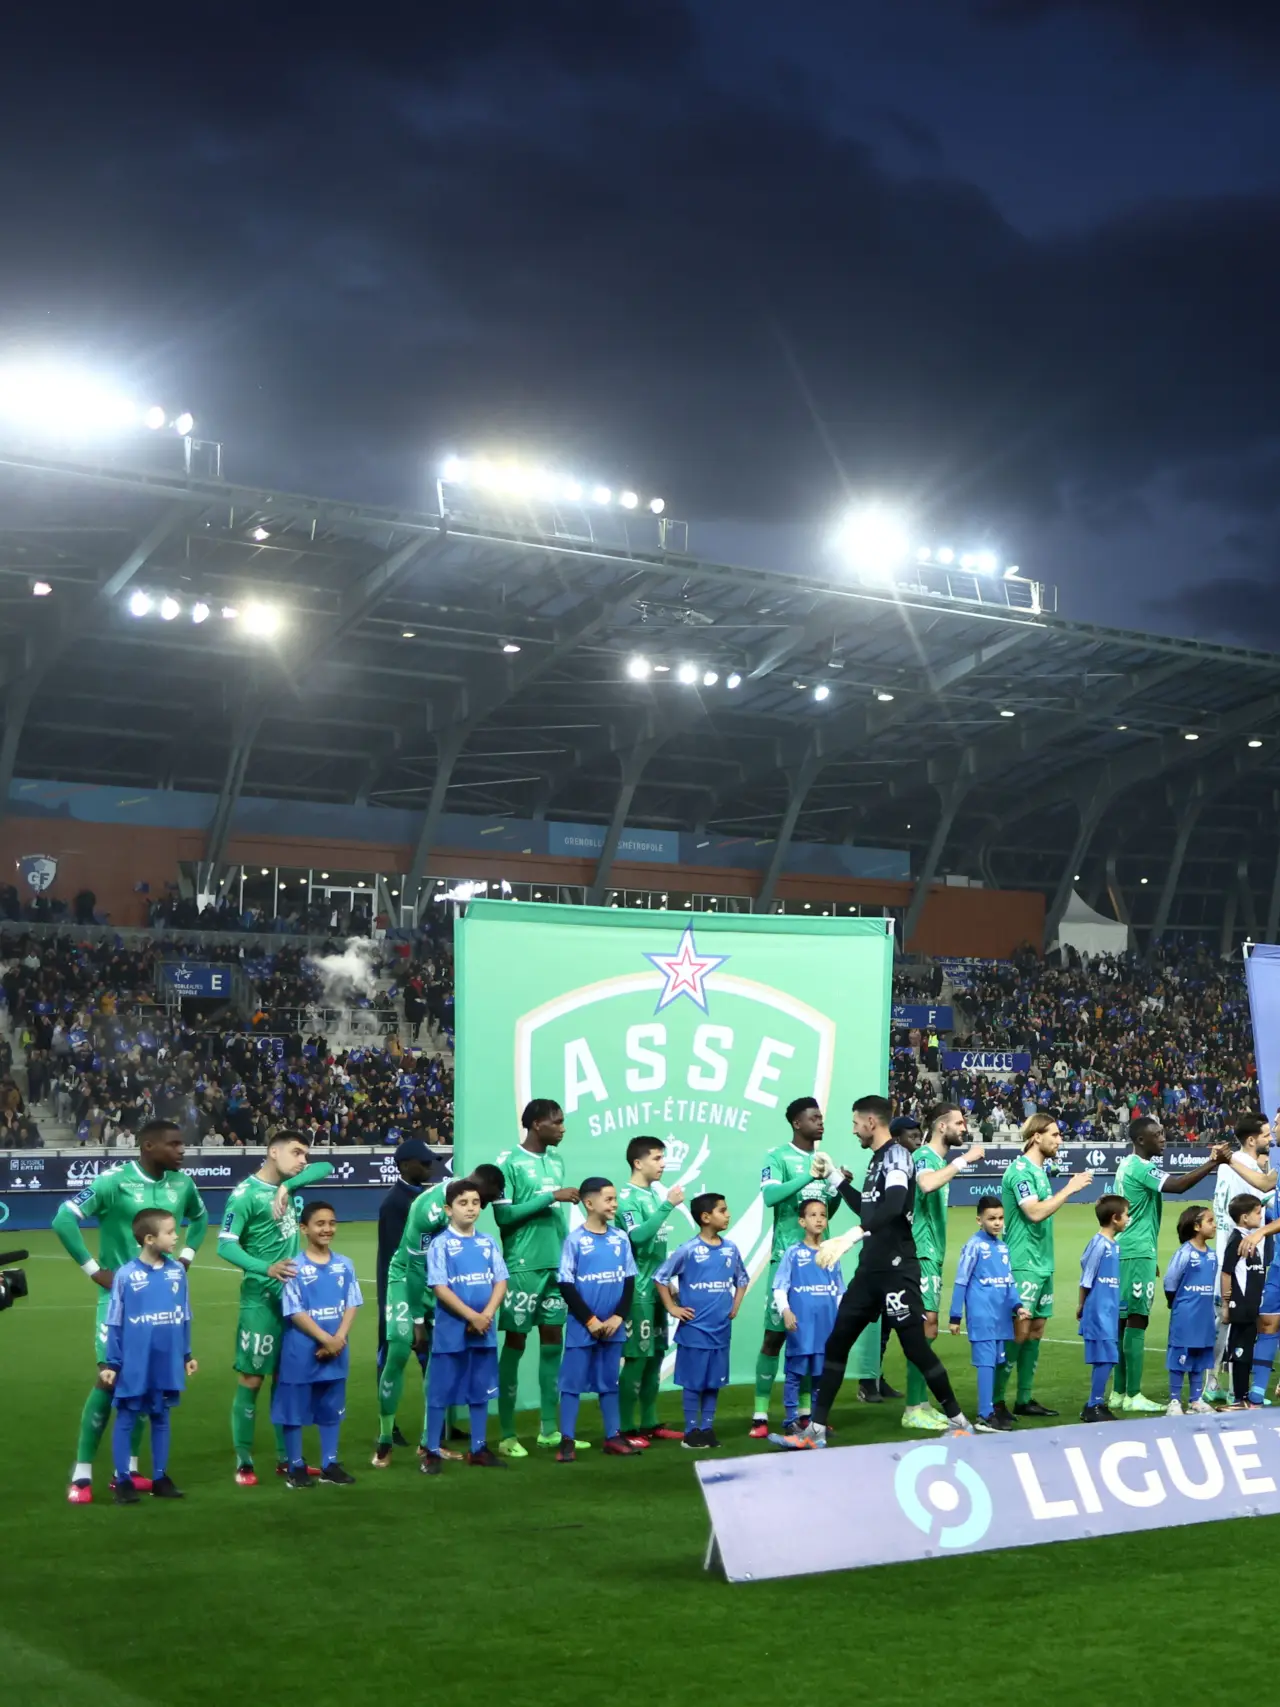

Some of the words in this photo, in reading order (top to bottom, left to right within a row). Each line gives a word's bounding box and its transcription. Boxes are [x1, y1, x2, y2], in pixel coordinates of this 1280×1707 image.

[211, 974, 223, 990] E
[928, 1010, 937, 1024] F
[564, 1022, 796, 1114] ASSE
[961, 1051, 1014, 1071] SAMSE
[588, 1096, 753, 1137] SAINT-ÉTIENNE
[1170, 1153, 1178, 1165] le
[178, 1166, 232, 1177] rovencia
[448, 1273, 487, 1283] VINCI
[578, 1271, 616, 1281] VINCI
[690, 1280, 728, 1290] VINCI
[794, 1284, 827, 1293] VINCI
[513, 1291, 538, 1313] 26
[129, 1311, 173, 1324] VINCI
[308, 1307, 338, 1316] INCI
[395, 1301, 409, 1322] 2
[640, 1319, 651, 1339] 6
[253, 1332, 274, 1355] 18
[1011, 1429, 1277, 1521] LIGUE
